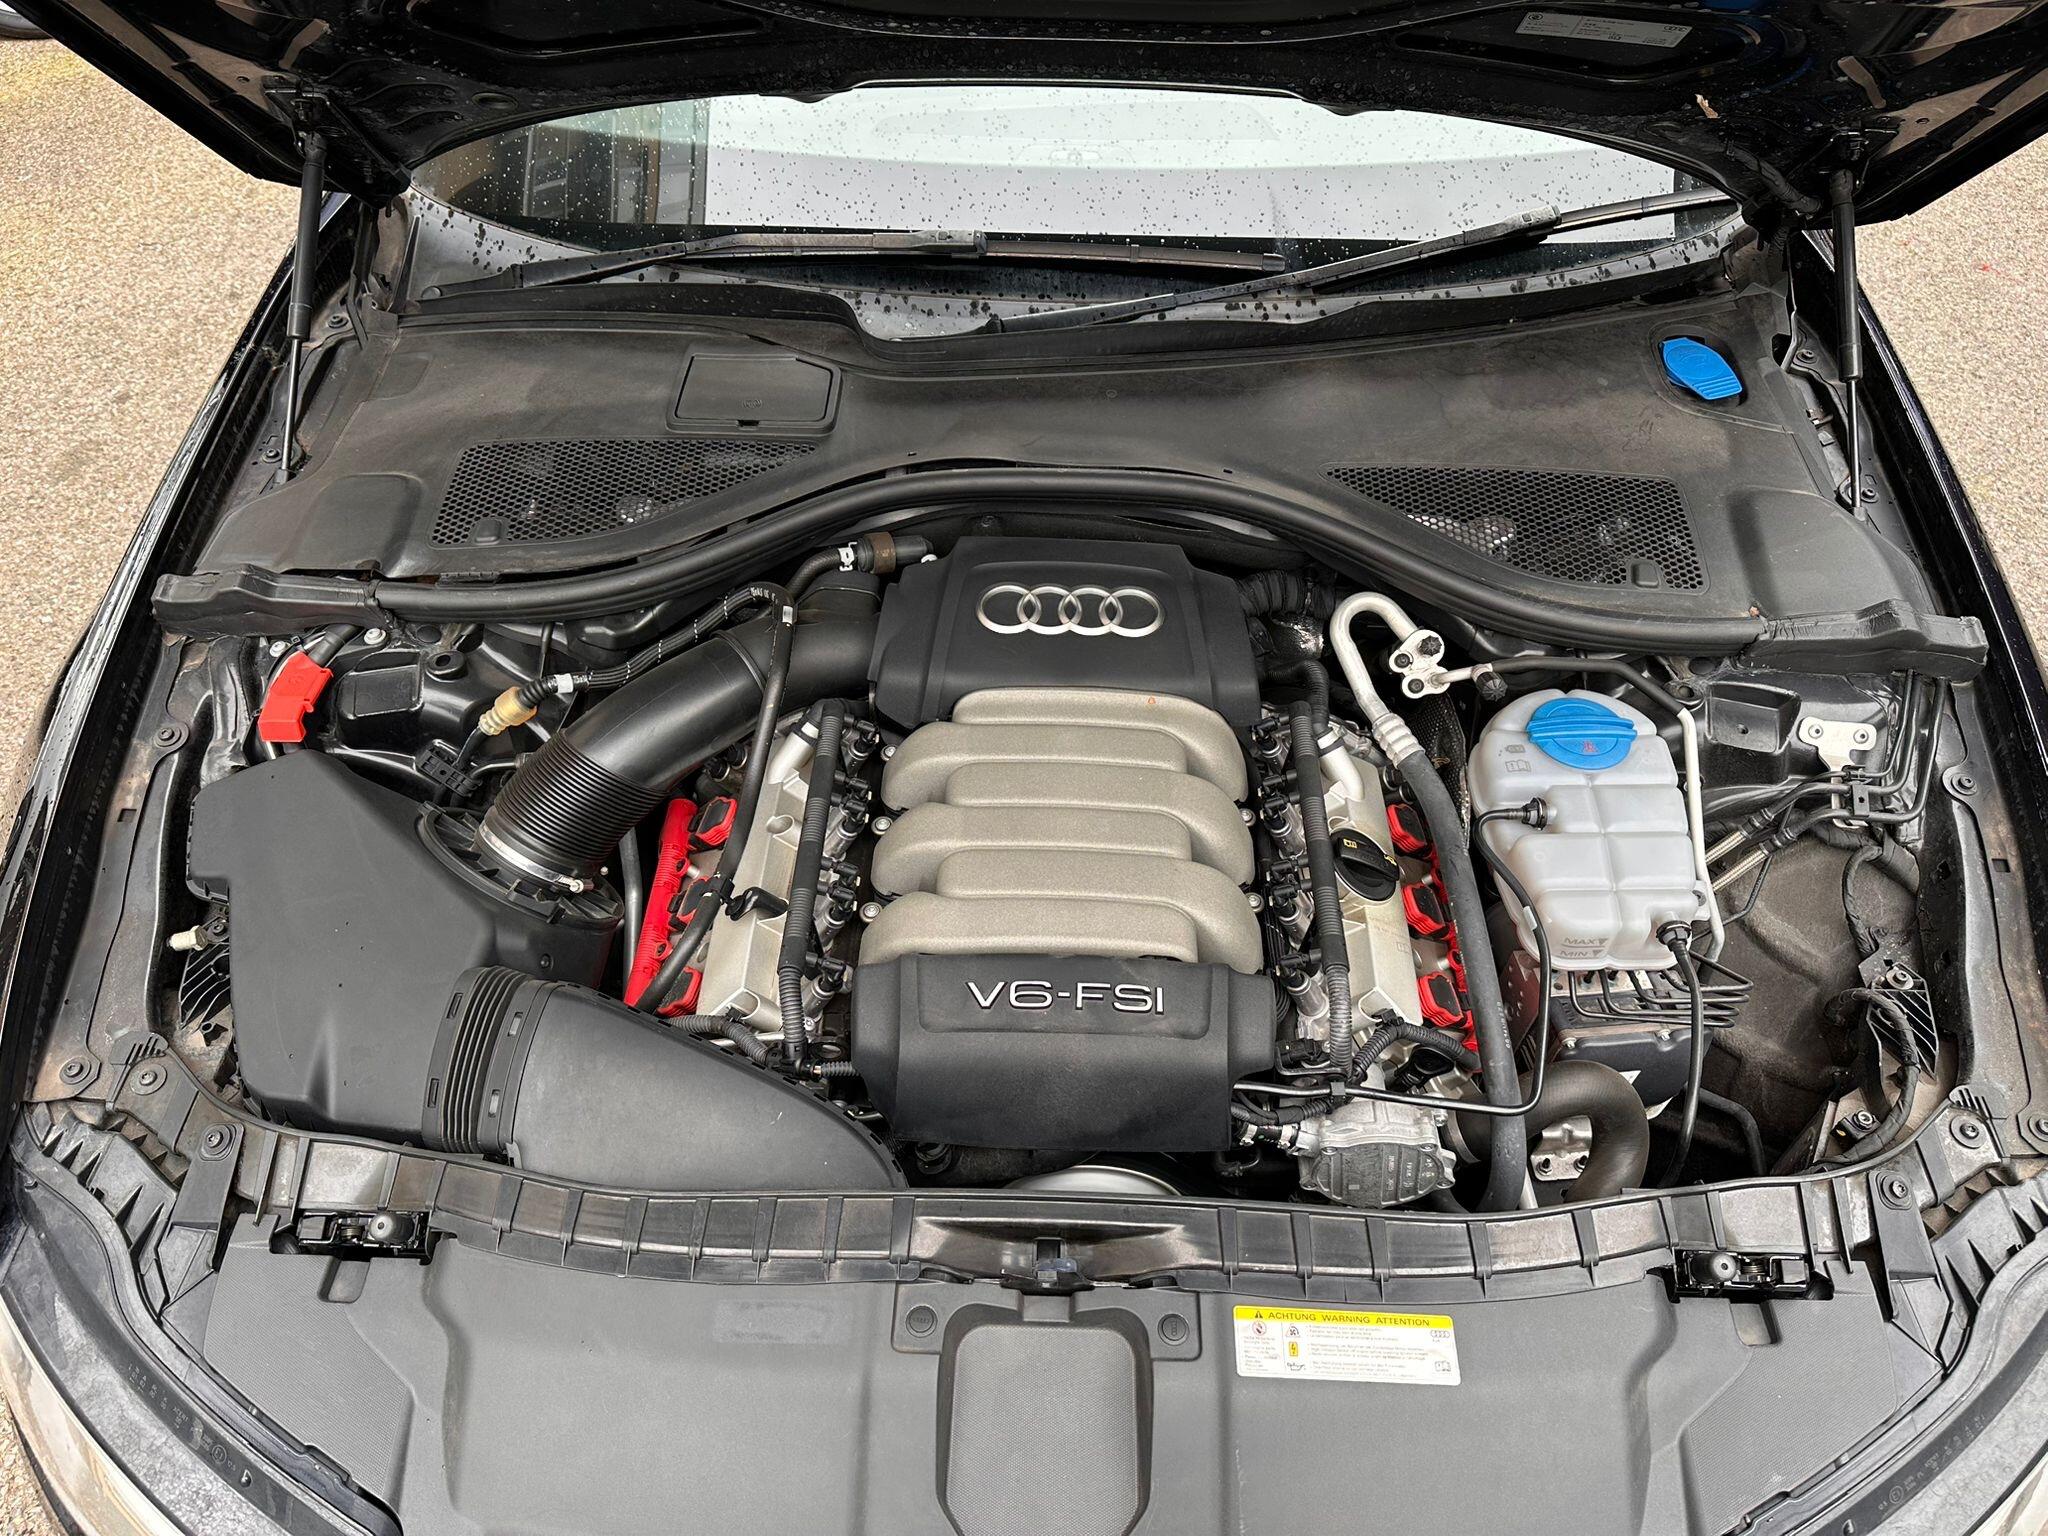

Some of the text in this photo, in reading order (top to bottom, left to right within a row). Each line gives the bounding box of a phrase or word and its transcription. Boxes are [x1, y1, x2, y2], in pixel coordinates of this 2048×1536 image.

[1563, 937, 1596, 945] MAX
[965, 980, 1164, 1015] V6-FSI
[1268, 1311, 1430, 1327] ACHTUNG WARNING ATTENTION
